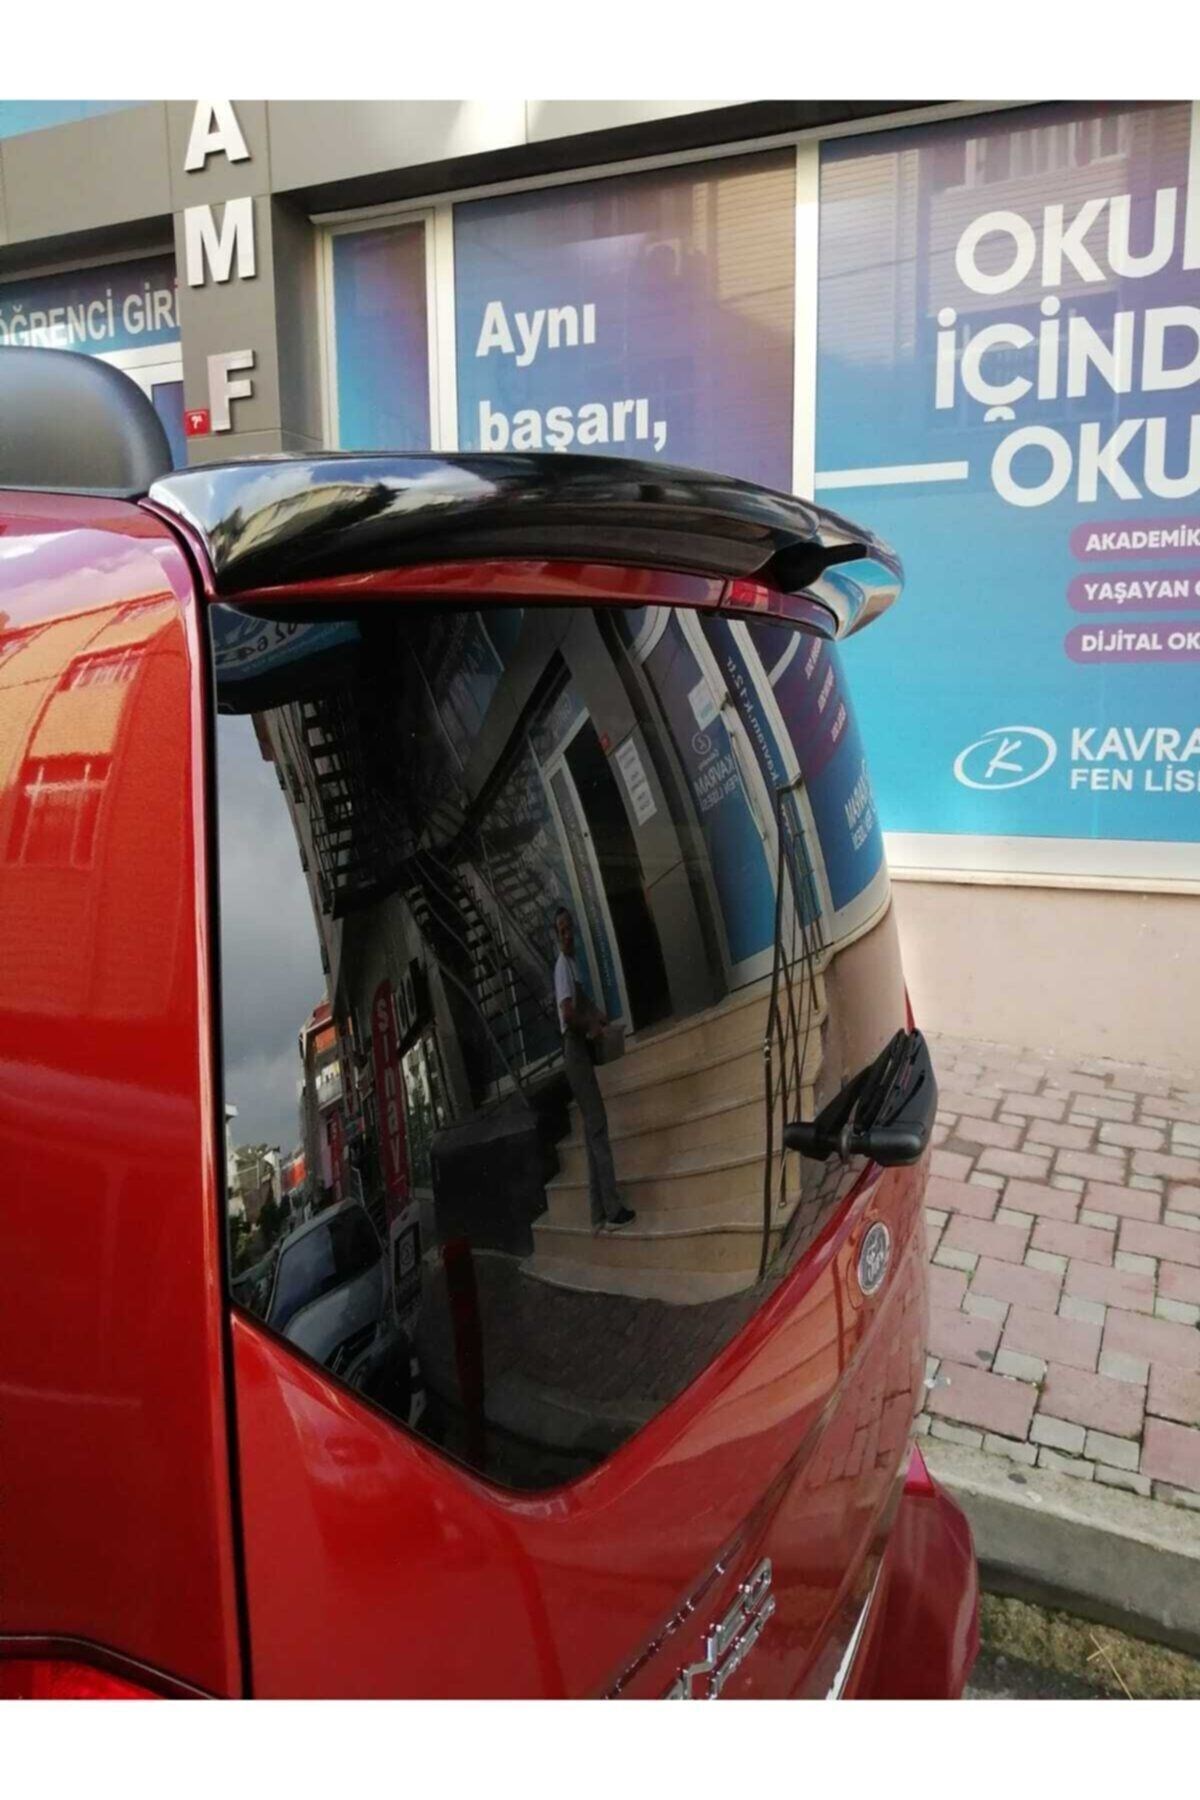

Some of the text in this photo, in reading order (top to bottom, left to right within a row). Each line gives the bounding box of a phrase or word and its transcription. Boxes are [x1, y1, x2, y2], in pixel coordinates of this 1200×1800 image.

[475, 300, 596, 367] Aynı
[479, 398, 667, 452] başarı,
[1085, 524, 1200, 552] AKADEMİK
[1084, 580, 1189, 604] YAŞAYAN
[1081, 628, 1200, 652] DİJİTAL OK
[1071, 727, 1200, 762] KAVRA
[1071, 764, 1200, 792] FEN LİS
